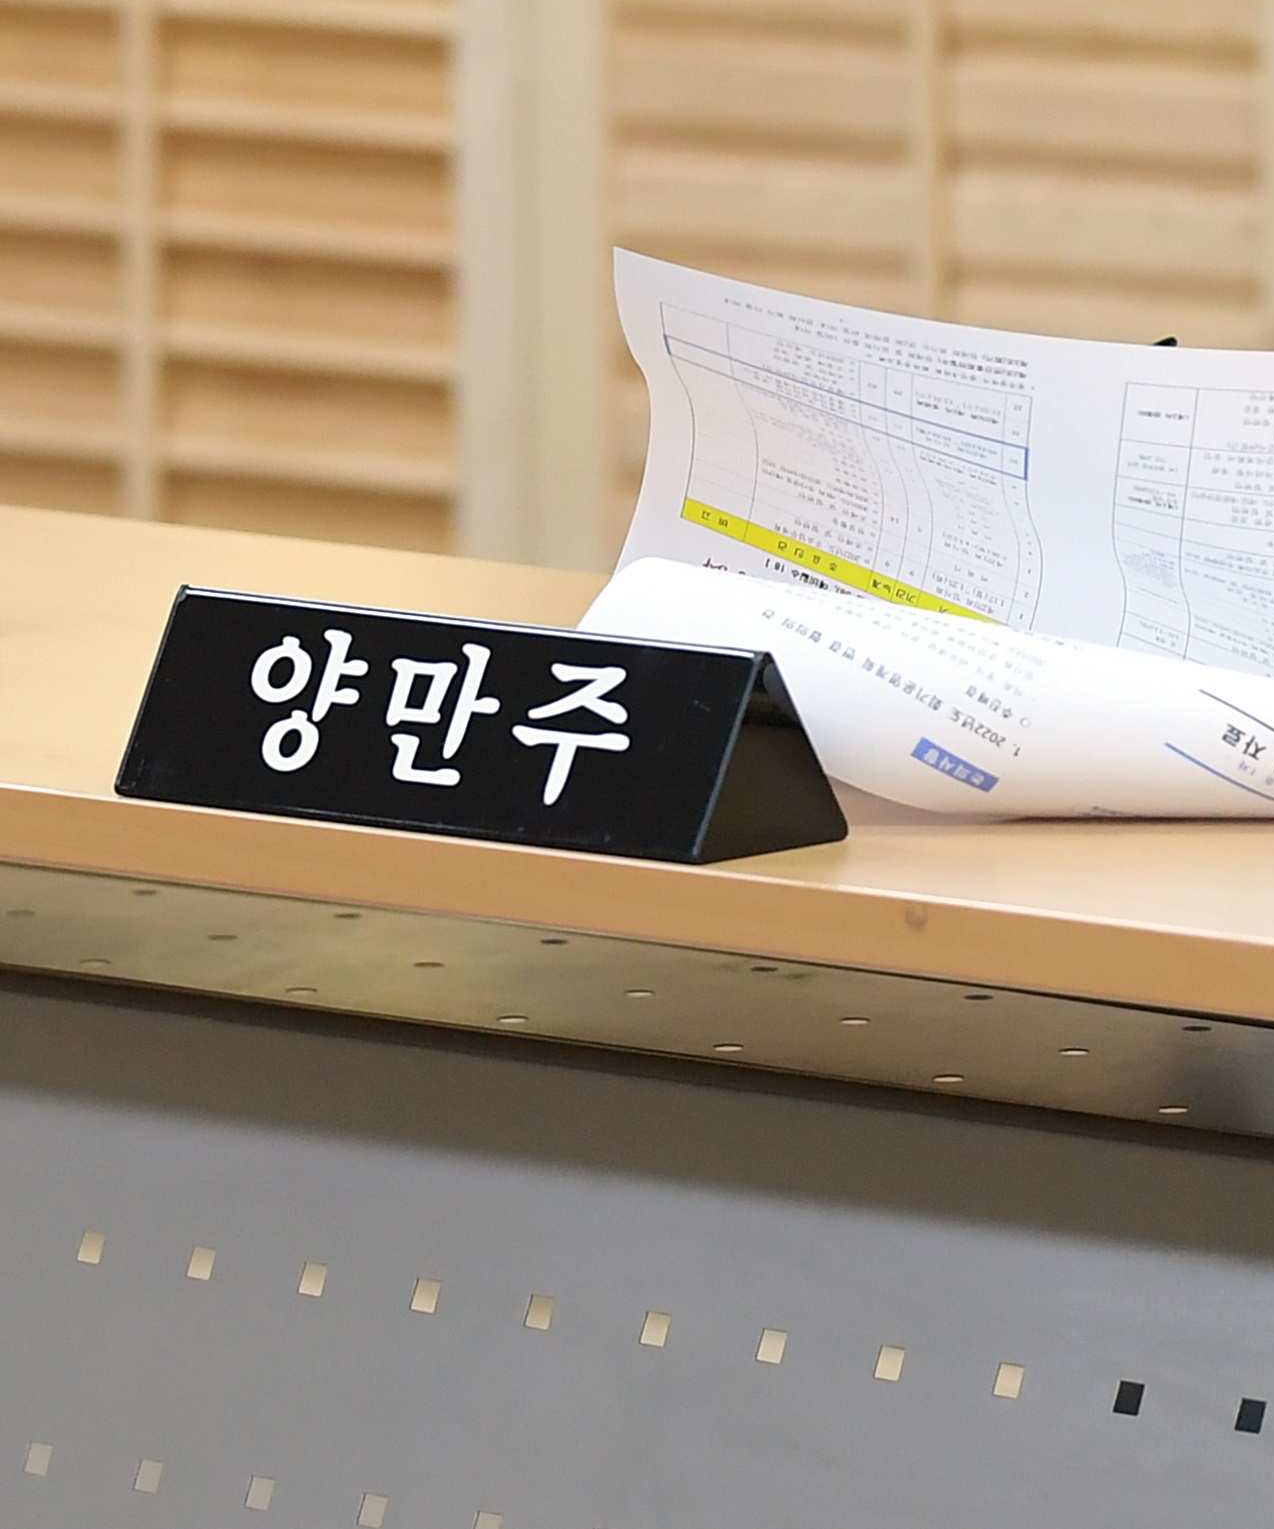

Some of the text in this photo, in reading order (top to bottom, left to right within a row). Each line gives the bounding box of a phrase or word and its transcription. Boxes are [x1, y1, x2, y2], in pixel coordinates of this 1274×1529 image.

[828, 640, 856, 662] 변경
[250, 628, 631, 806] 양만주
[948, 707, 1006, 748] 2022년도
[1221, 723, 1266, 761] 자료
